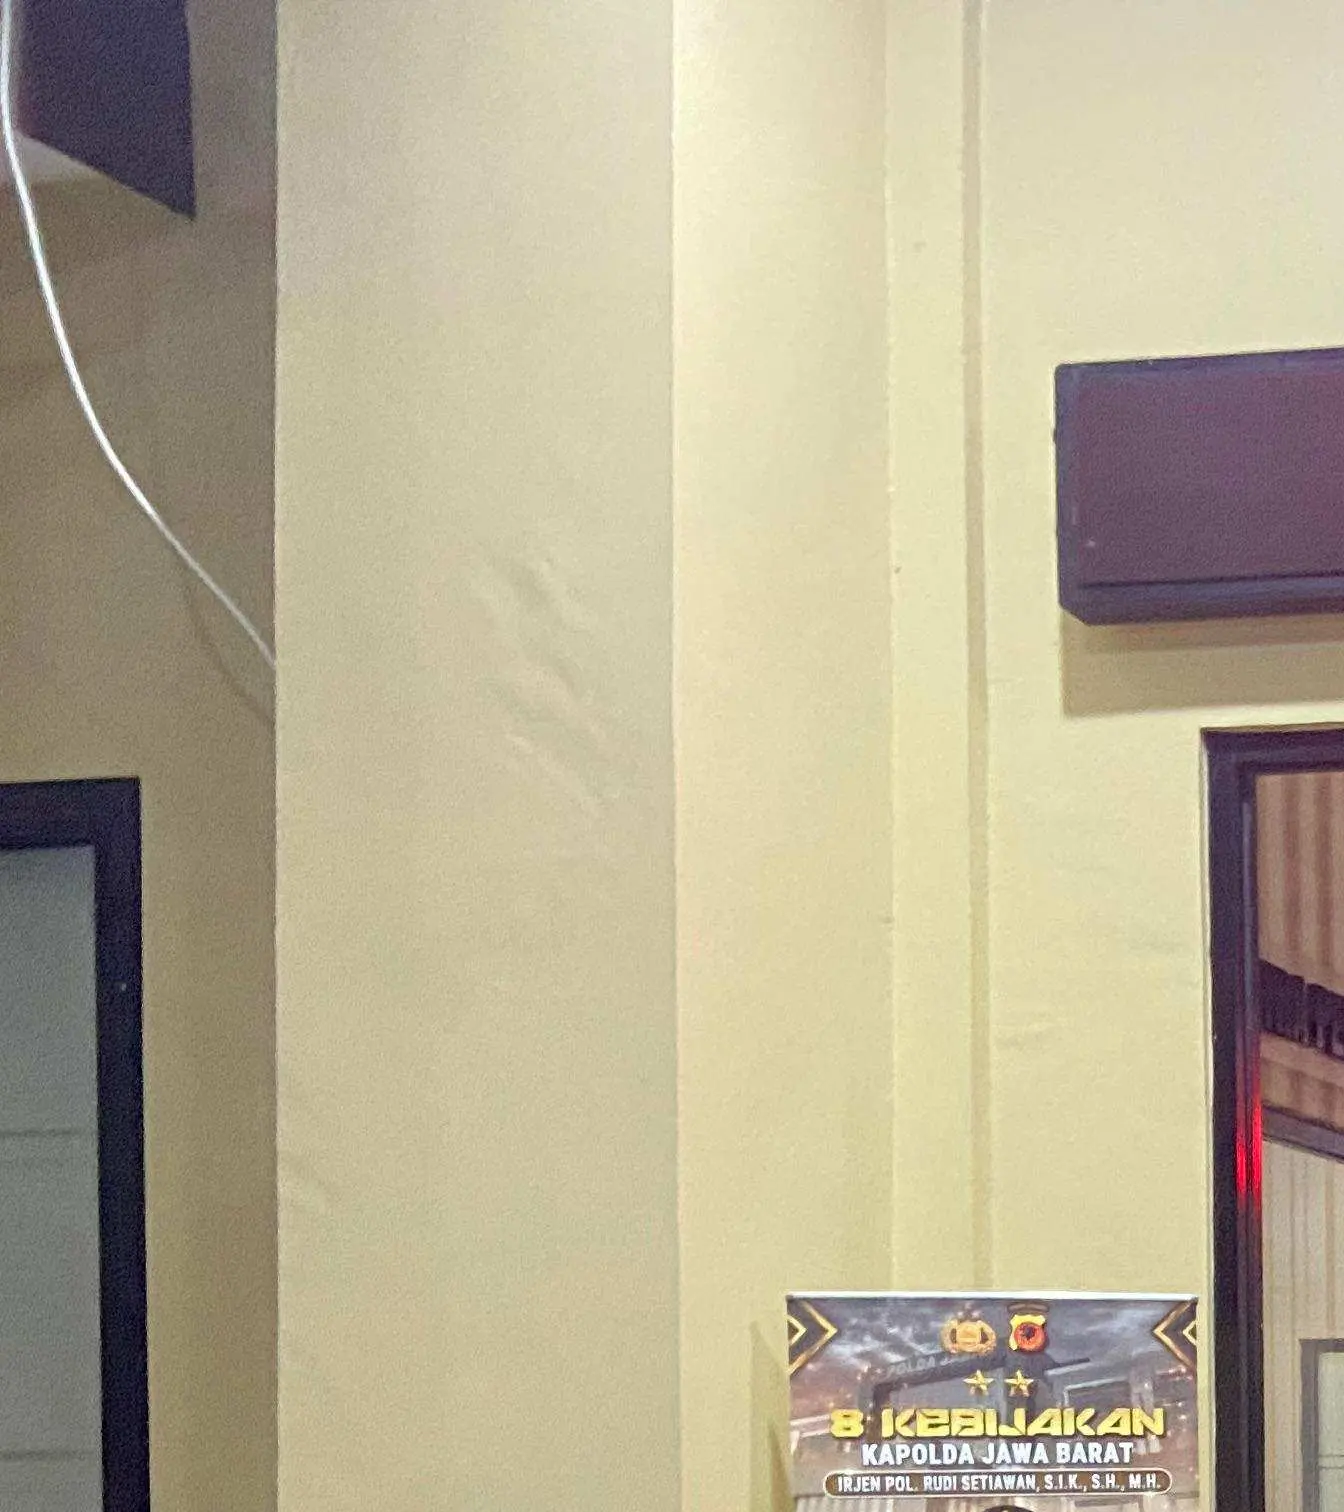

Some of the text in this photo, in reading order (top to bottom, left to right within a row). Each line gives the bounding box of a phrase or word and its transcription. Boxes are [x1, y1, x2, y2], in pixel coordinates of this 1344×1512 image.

[830, 1407, 1166, 1437] 8 KEBIJAKAN
[862, 1442, 1133, 1465] KAPOLDA JAWA BARAT
[838, 1475, 881, 1492] IRJEN
[924, 1475, 957, 1490] RUDI
